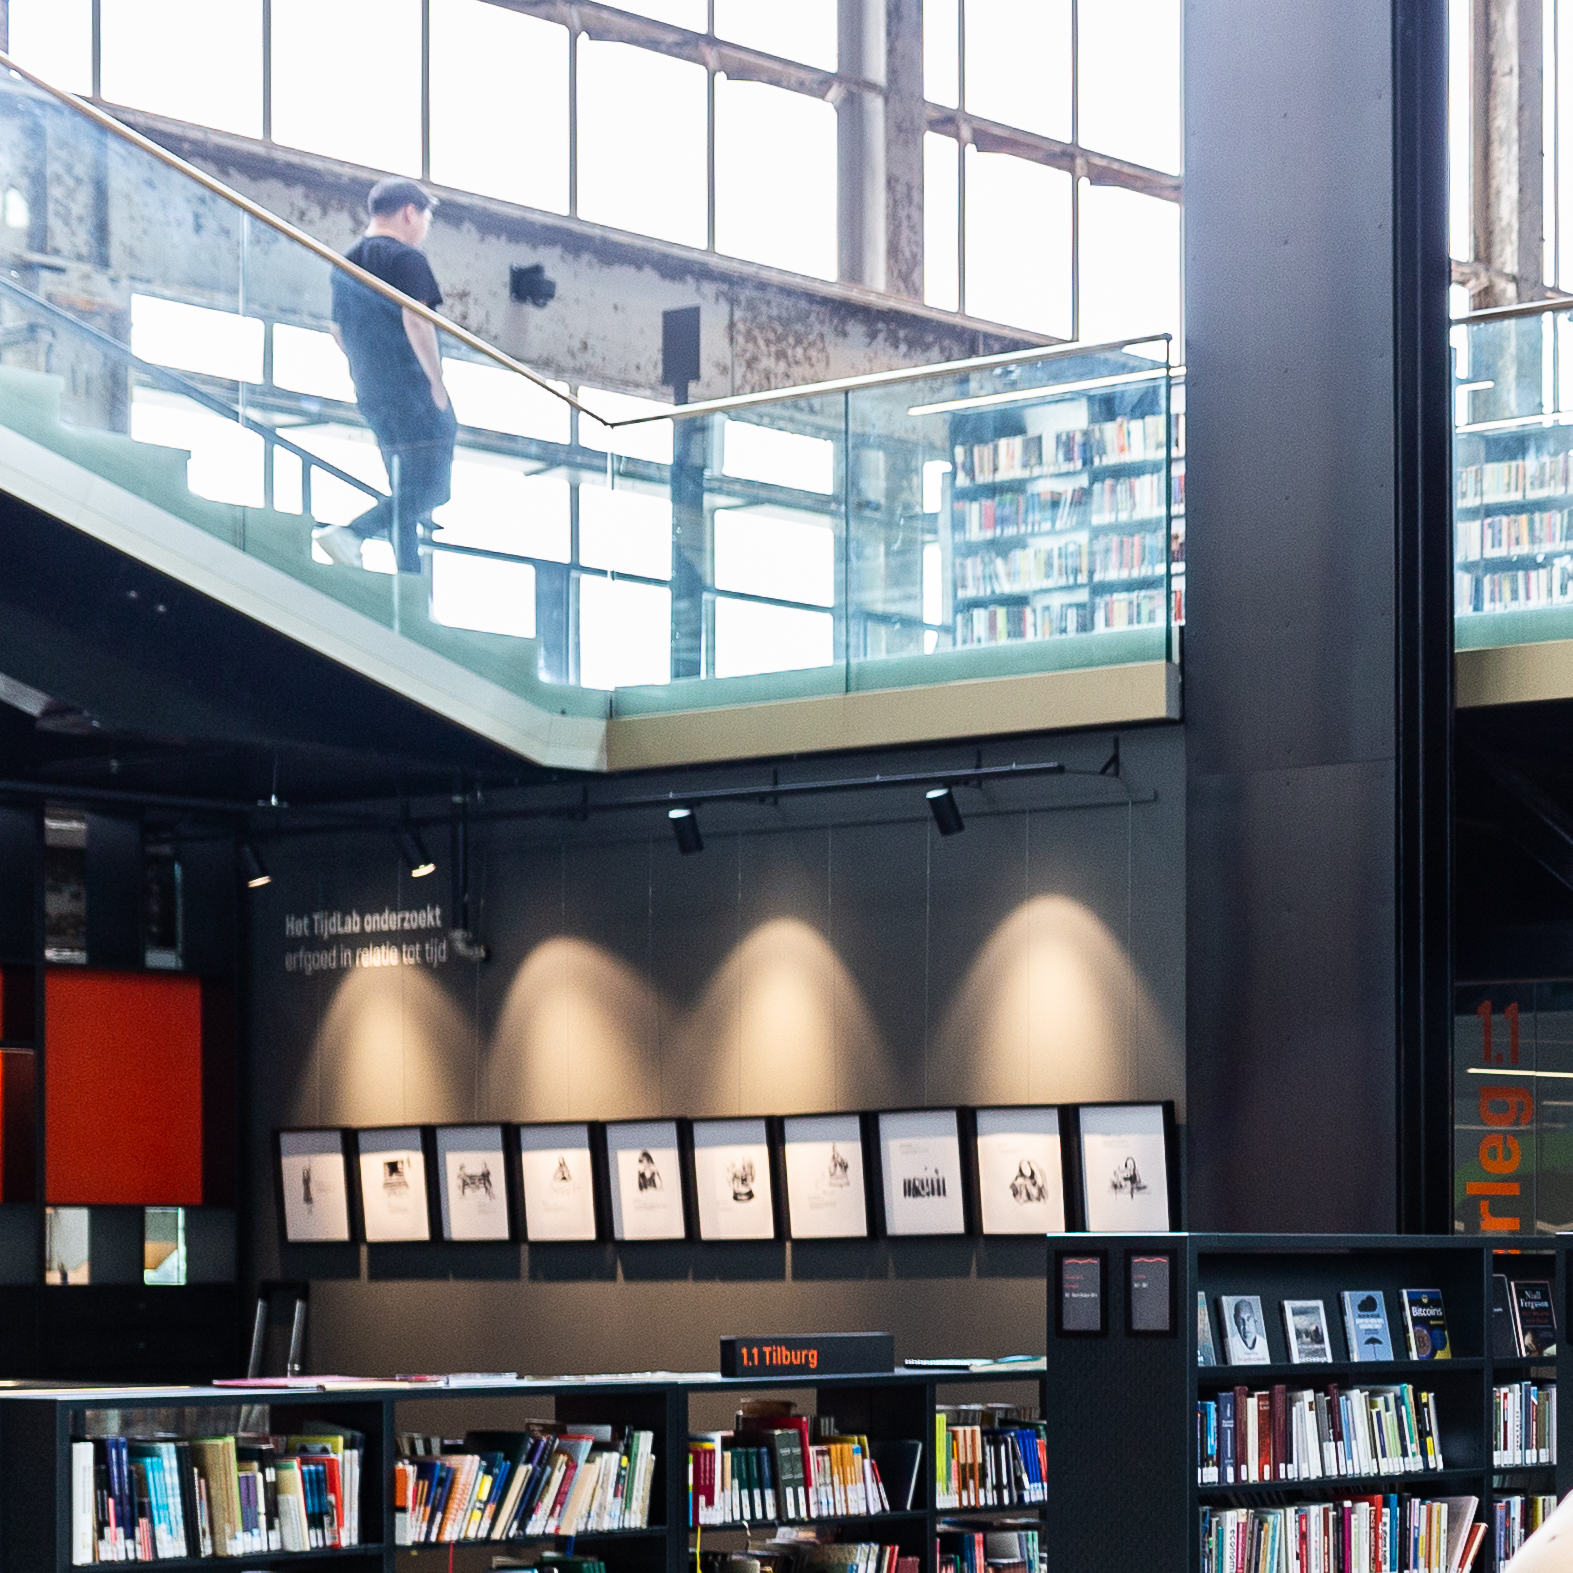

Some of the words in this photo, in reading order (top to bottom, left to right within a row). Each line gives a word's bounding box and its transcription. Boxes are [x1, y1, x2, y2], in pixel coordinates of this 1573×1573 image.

[285, 914, 310, 938] Het
[312, 908, 361, 940] TijdLab
[363, 904, 442, 934] onderzoekt
[339, 943, 352, 969] in
[355, 940, 399, 968] relatie
[401, 941, 421, 965] tot
[424, 937, 447, 968] tijd
[1466, 1085, 1534, 1232] rleg
[1411, 1305, 1443, 1318] Bitcoins
[741, 1346, 759, 1367] 1.1
[762, 1345, 818, 1369] Tilburg
